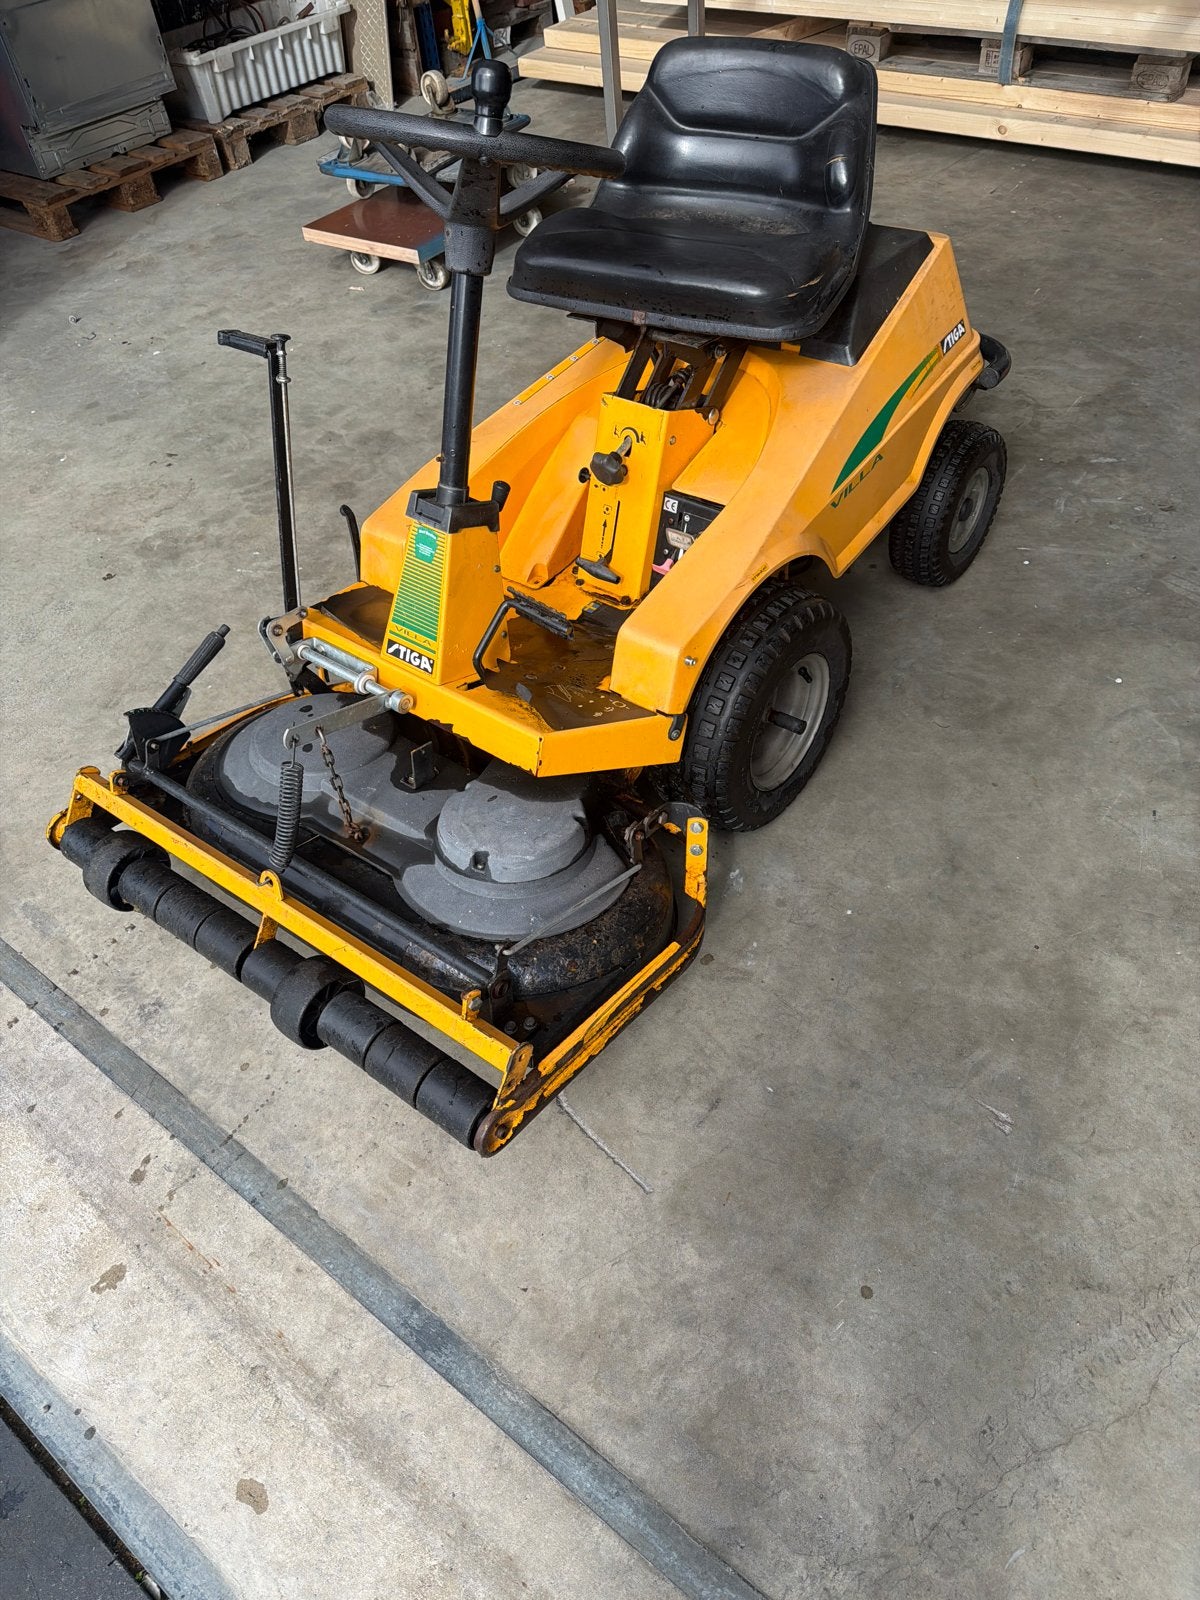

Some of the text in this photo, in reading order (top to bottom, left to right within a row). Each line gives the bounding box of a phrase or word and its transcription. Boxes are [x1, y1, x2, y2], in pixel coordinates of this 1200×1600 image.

[853, 43, 871, 56] EPAL
[943, 322, 965, 354] STIGA
[830, 453, 883, 508] VILLA
[665, 499, 677, 512] CE
[395, 625, 432, 647] VILLA
[387, 643, 433, 673] STIGA
